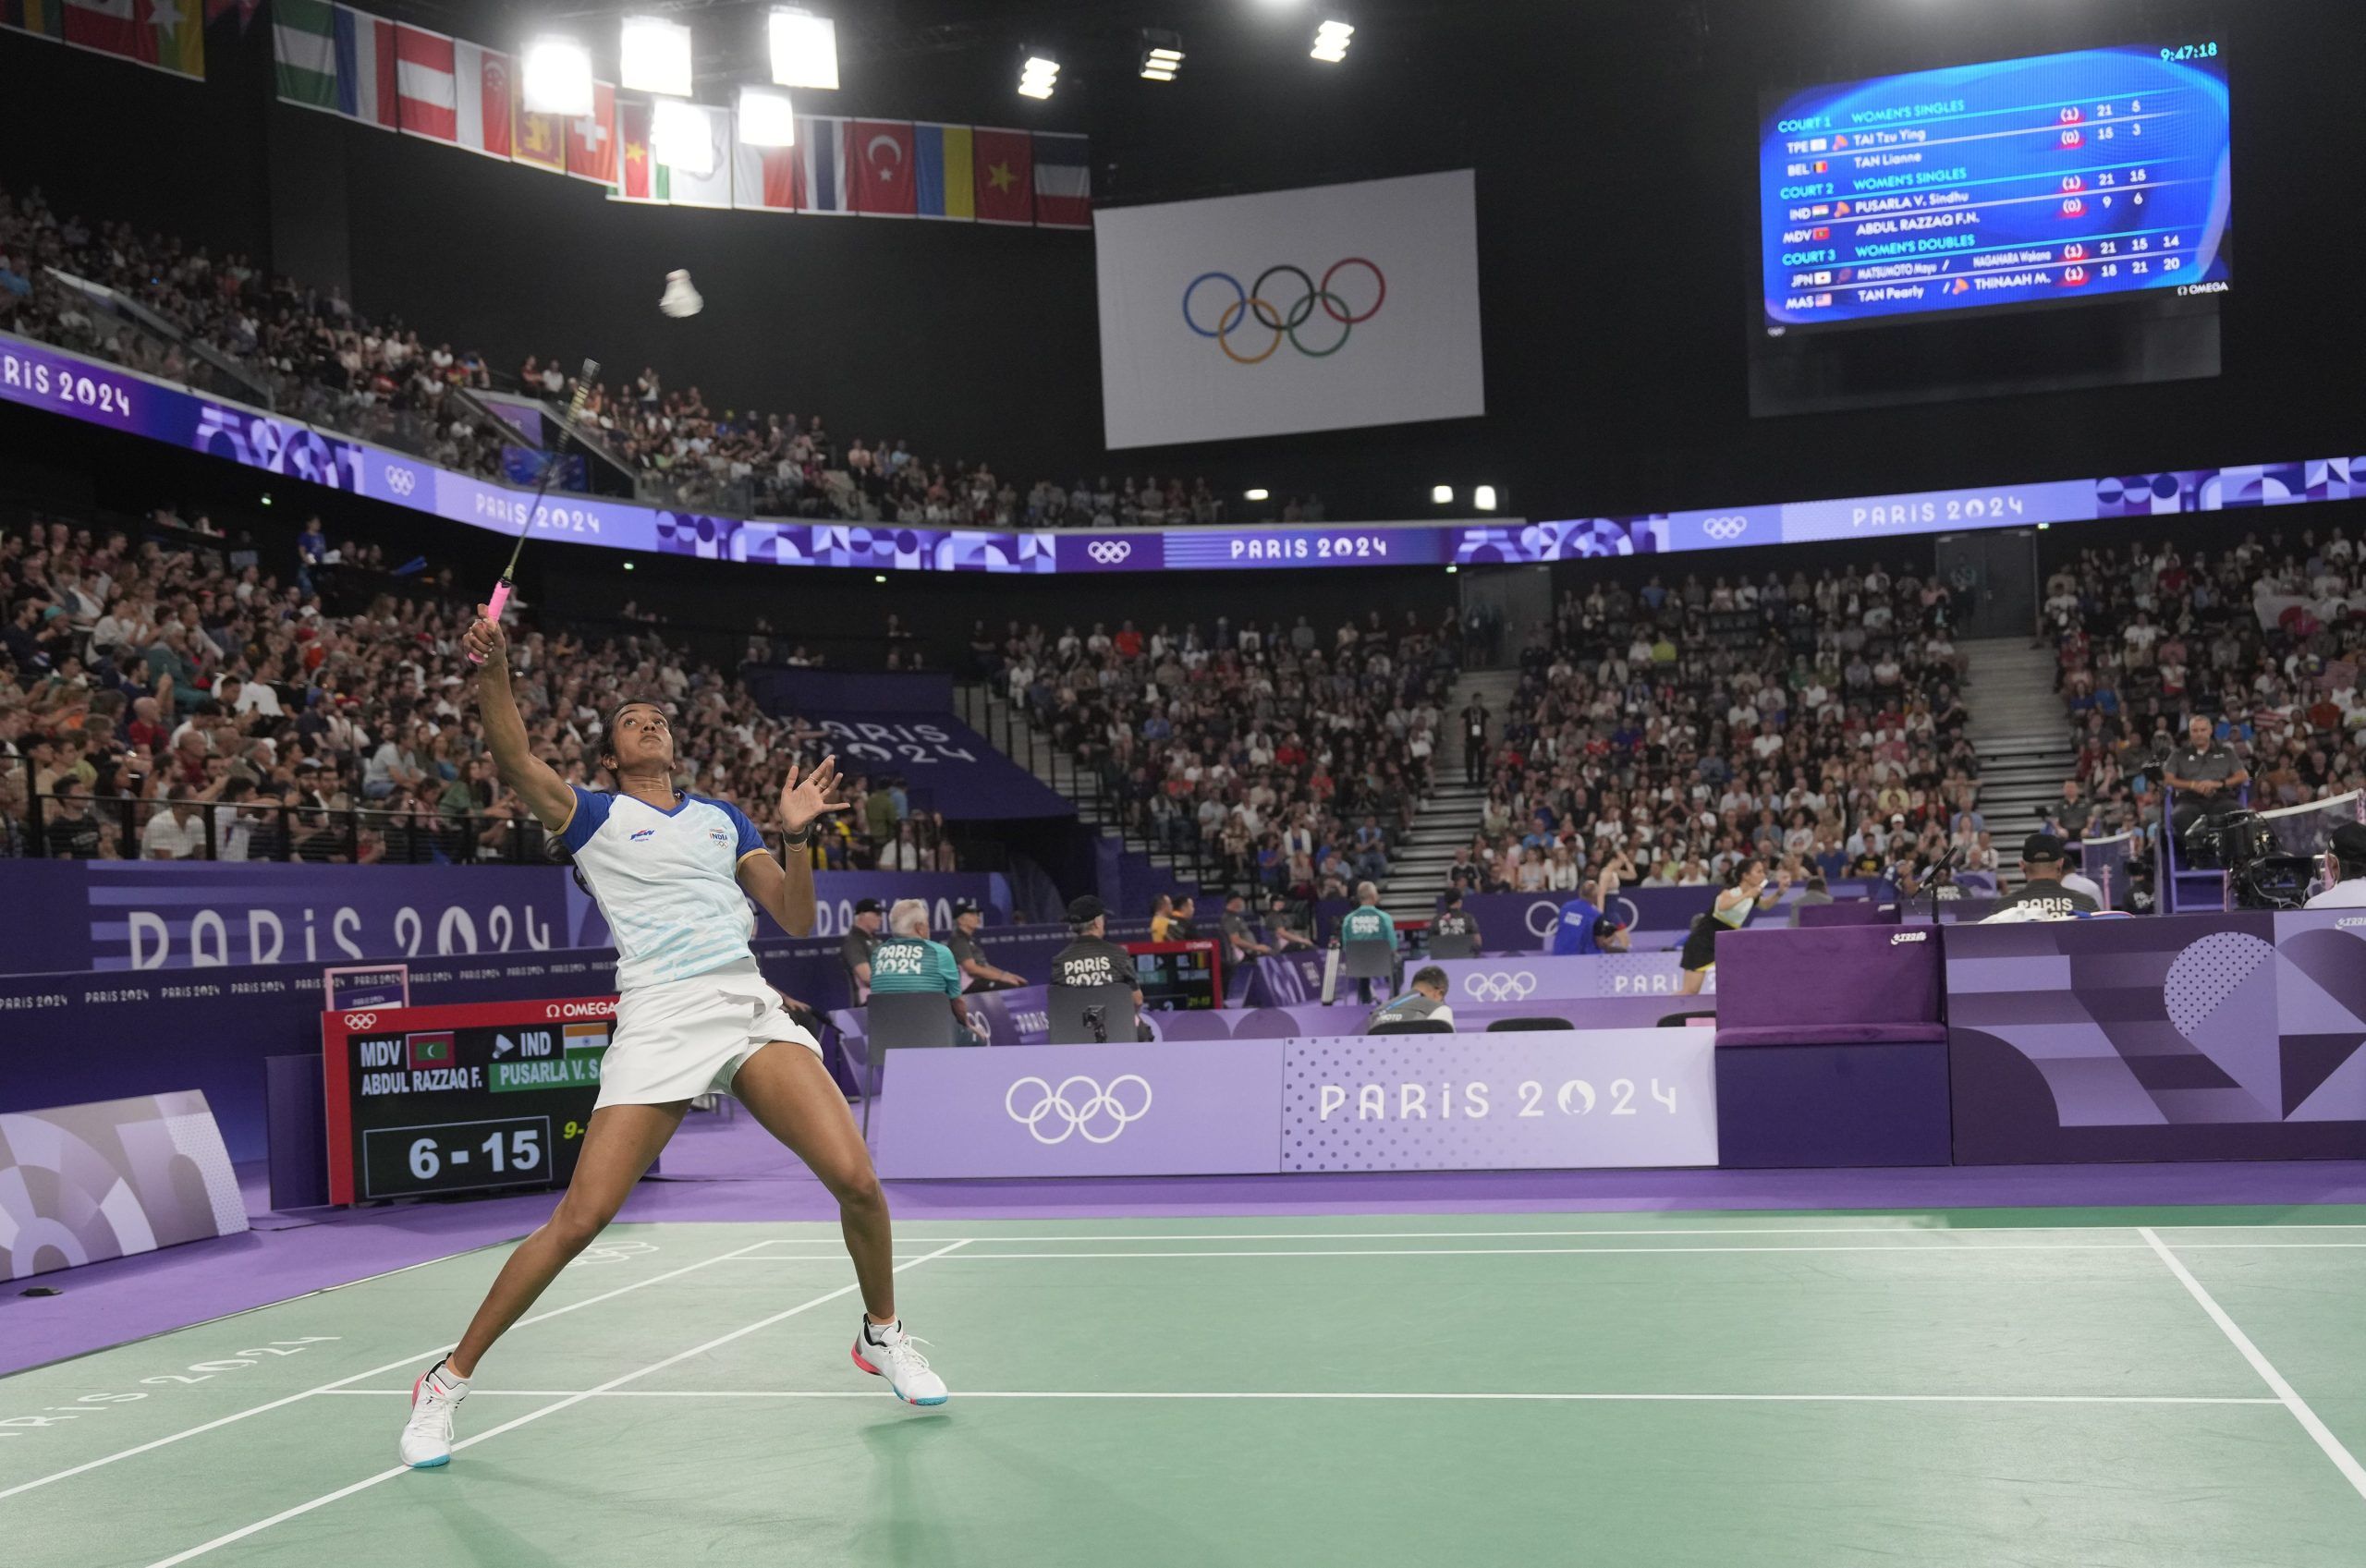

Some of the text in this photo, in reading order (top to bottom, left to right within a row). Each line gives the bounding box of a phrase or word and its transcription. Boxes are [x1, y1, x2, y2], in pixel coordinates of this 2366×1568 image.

[2161, 42, 2217, 62] 9:47:18
[1778, 100, 1965, 133] COURT 1 WOMEN'S SINGLES
[1787, 140, 1810, 154] TPE
[1853, 132, 1874, 146] TAI
[1876, 131, 1897, 144] Tzu
[1898, 128, 1926, 142] Ying
[2097, 103, 2113, 116] 21
[2131, 100, 2140, 113] 5
[1787, 164, 1810, 177] BEL
[1854, 155, 1881, 169] TAN
[1883, 152, 1922, 166] Lianne
[2132, 124, 2141, 136] 3
[1780, 166, 1967, 200] COURT 2 WOMEN'S SINGLES
[1789, 208, 1811, 222] IND
[1856, 197, 1912, 213] PUSARLA
[1913, 194, 1927, 207] V.
[1929, 190, 1970, 205] Sindhu
[2099, 173, 2115, 186] 21
[1783, 229, 1812, 244] MDV
[1856, 220, 1898, 237] ABDUL
[1900, 214, 1954, 232] RAZZAQ
[1956, 212, 1980, 225] F.N.
[2103, 196, 2113, 209] 9
[2133, 192, 2143, 205] 6
[1782, 233, 1976, 266] COURT 3 WOMEN'S DOUBLES
[1791, 273, 1813, 287] JPN
[1858, 264, 1913, 281] MATSUMOTO
[2100, 241, 2116, 255] 21
[2163, 235, 2179, 248] 14
[1786, 296, 1814, 310] MAS
[1858, 289, 1884, 303] TAN
[1886, 285, 1924, 300] Pearly
[1975, 273, 2031, 291] THINAAH
[2033, 271, 2052, 285] M.
[2101, 263, 2116, 277] 18
[2133, 261, 2149, 275] 21
[2164, 257, 2180, 271] 20
[2189, 282, 2229, 295] OMEGA
[59, 371, 130, 417] 2024
[536, 505, 600, 534] 2024
[1946, 495, 2022, 520] 2024
[1317, 537, 1386, 556] 2024
[874, 959, 921, 976] 2024
[1066, 970, 1113, 987] 2024
[563, 1002, 617, 1016] OMEGA
[360, 1040, 401, 1067] MDV
[519, 1031, 552, 1057] IND
[361, 1066, 482, 1096] ABDUL RAZZAQ F.
[500, 1061, 569, 1086] PUSARLA
[571, 1060, 585, 1081] V.
[1518, 1077, 1677, 1116] 2024
[409, 1138, 440, 1180] 6
[482, 1129, 541, 1173] 15
